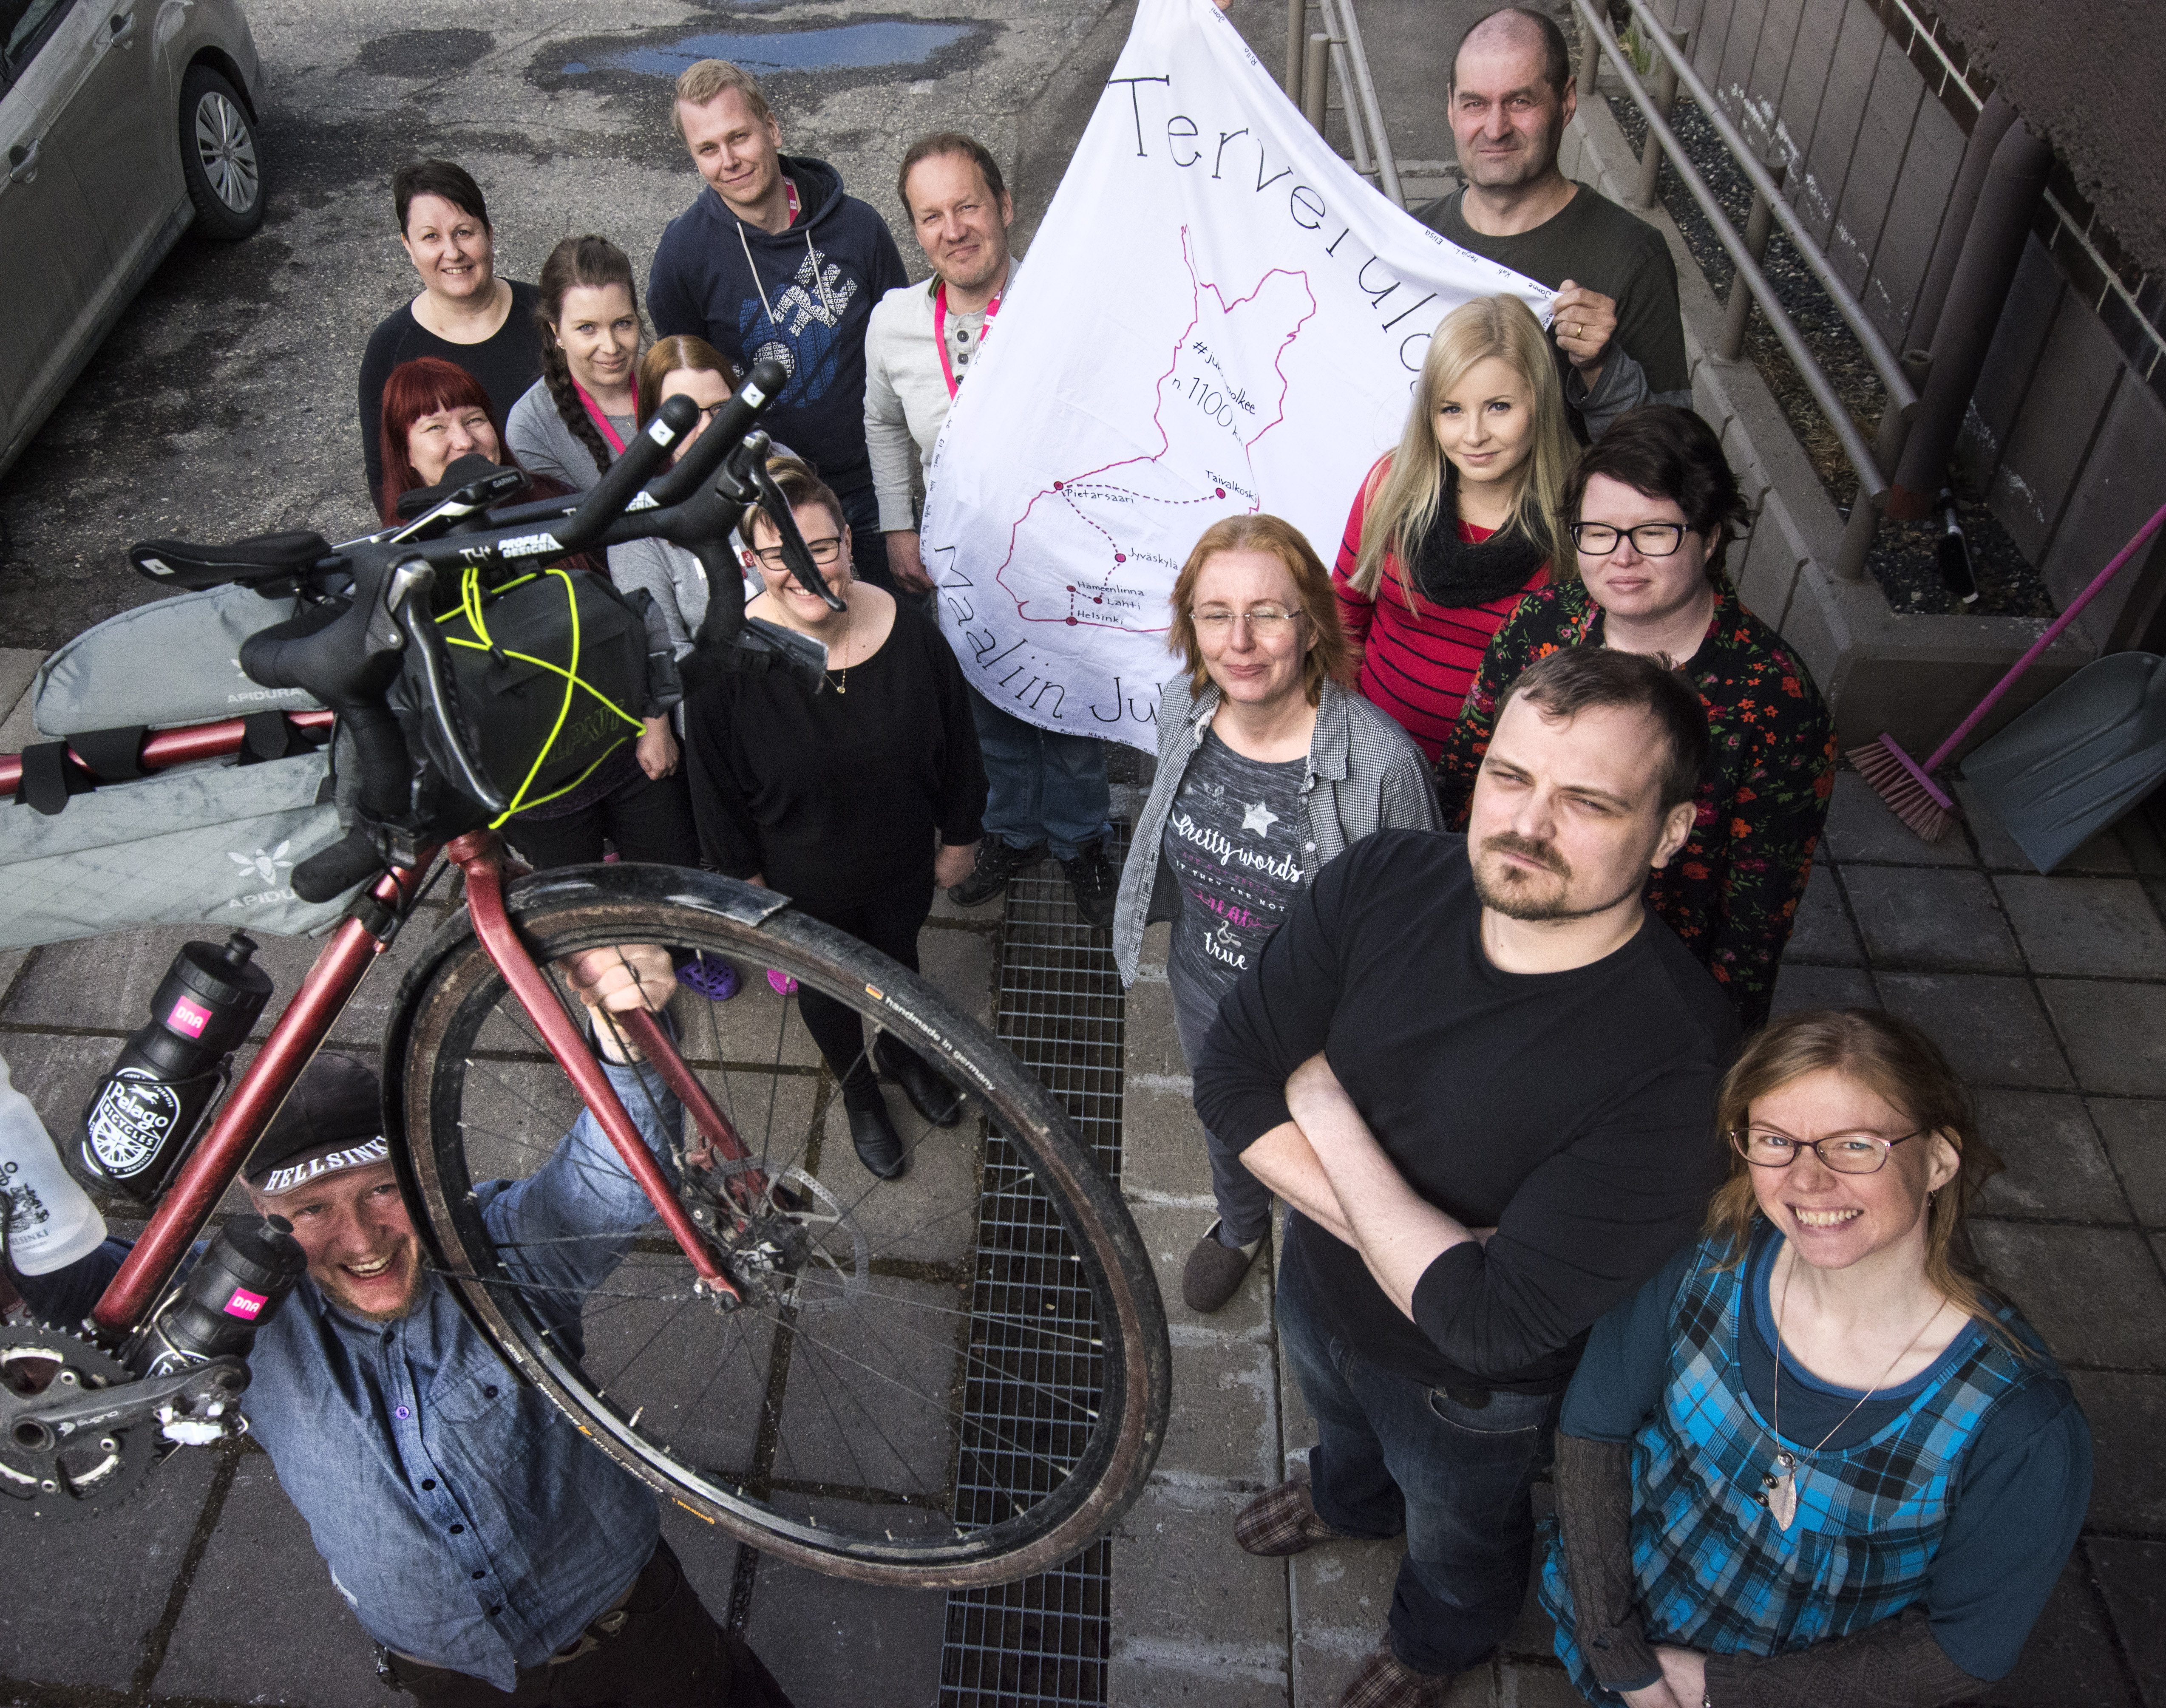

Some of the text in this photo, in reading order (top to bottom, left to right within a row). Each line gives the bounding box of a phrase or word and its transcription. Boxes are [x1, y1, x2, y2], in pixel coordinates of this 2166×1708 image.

[1209, 7, 1225, 23] Joni
[1106, 75, 1432, 397] Terveulo
[1425, 229, 1444, 246] Elisa
[1496, 268, 1511, 279] Kati
[1528, 283, 1551, 299] Janne
[1189, 377, 1233, 427] 1100
[1064, 488, 1134, 504] Pietarsaari
[1205, 470, 1258, 503] Taivalkoski
[498, 533, 549, 551] PROFILE
[502, 543, 549, 558] DESIGN
[1128, 547, 1179, 571] Jyväskylä
[1107, 598, 1141, 610] Lahti
[1077, 610, 1124, 625] Helsinki
[934, 546, 1162, 725] Maaliin Ju
[227, 688, 302, 703] APIDURA
[1237, 849, 1305, 884] words
[1176, 860, 1285, 912] IF THEY ARE NOT
[229, 887, 299, 909] APIDU
[1216, 920, 1242, 948] &
[1203, 931, 1248, 970] true
[175, 1006, 204, 1029] DNA
[885, 996, 996, 1091] handmade in Germany
[111, 1082, 169, 1130] Pelago
[103, 1103, 155, 1146] BICYCLES
[9, 1228, 49, 1247] ELSINKI
[232, 1295, 261, 1313] DNA
[677, 1498, 715, 1525] Continental
